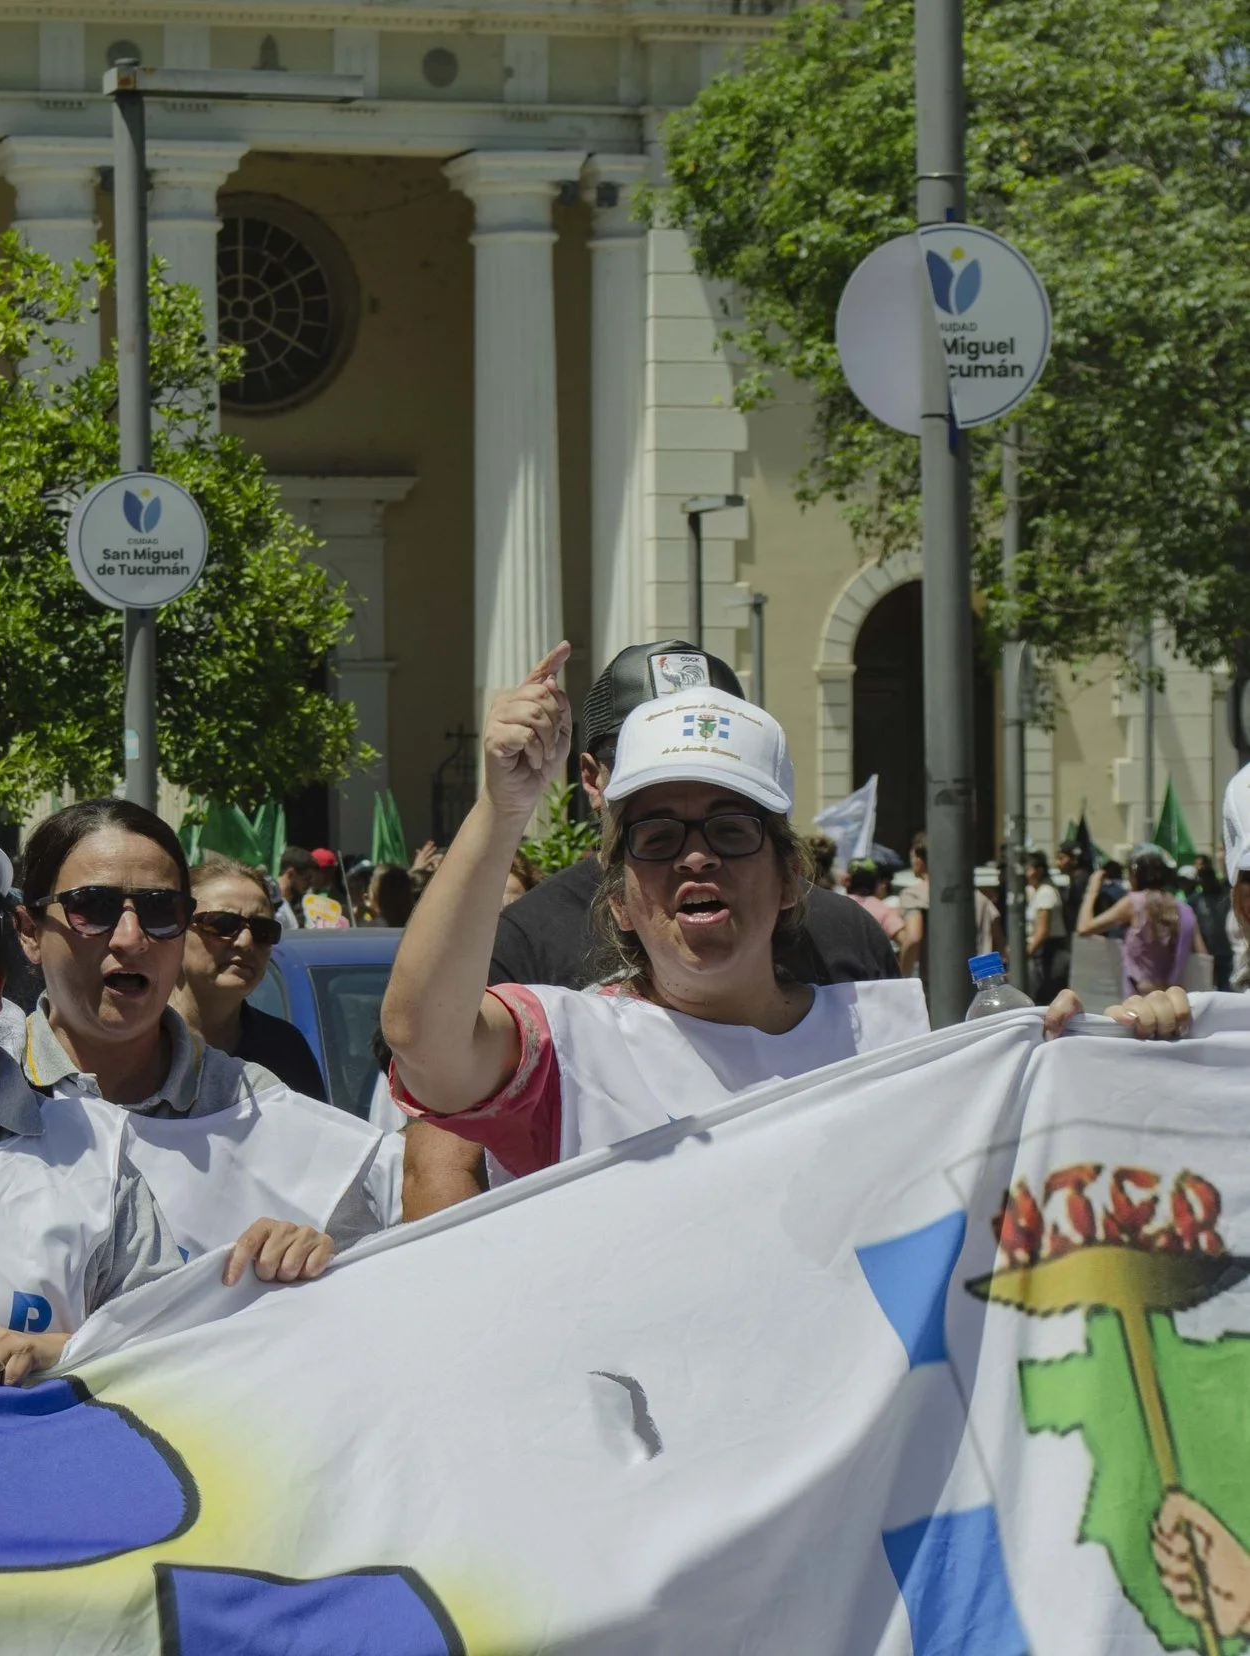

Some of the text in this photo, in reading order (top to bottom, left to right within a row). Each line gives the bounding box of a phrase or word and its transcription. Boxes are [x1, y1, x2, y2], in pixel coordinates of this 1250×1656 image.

[940, 322, 978, 332] IUDAD
[943, 335, 1015, 361] Miguel
[947, 358, 1024, 378] cumán
[102, 546, 184, 564] San Miguel
[97, 562, 190, 575] de Tucumán
